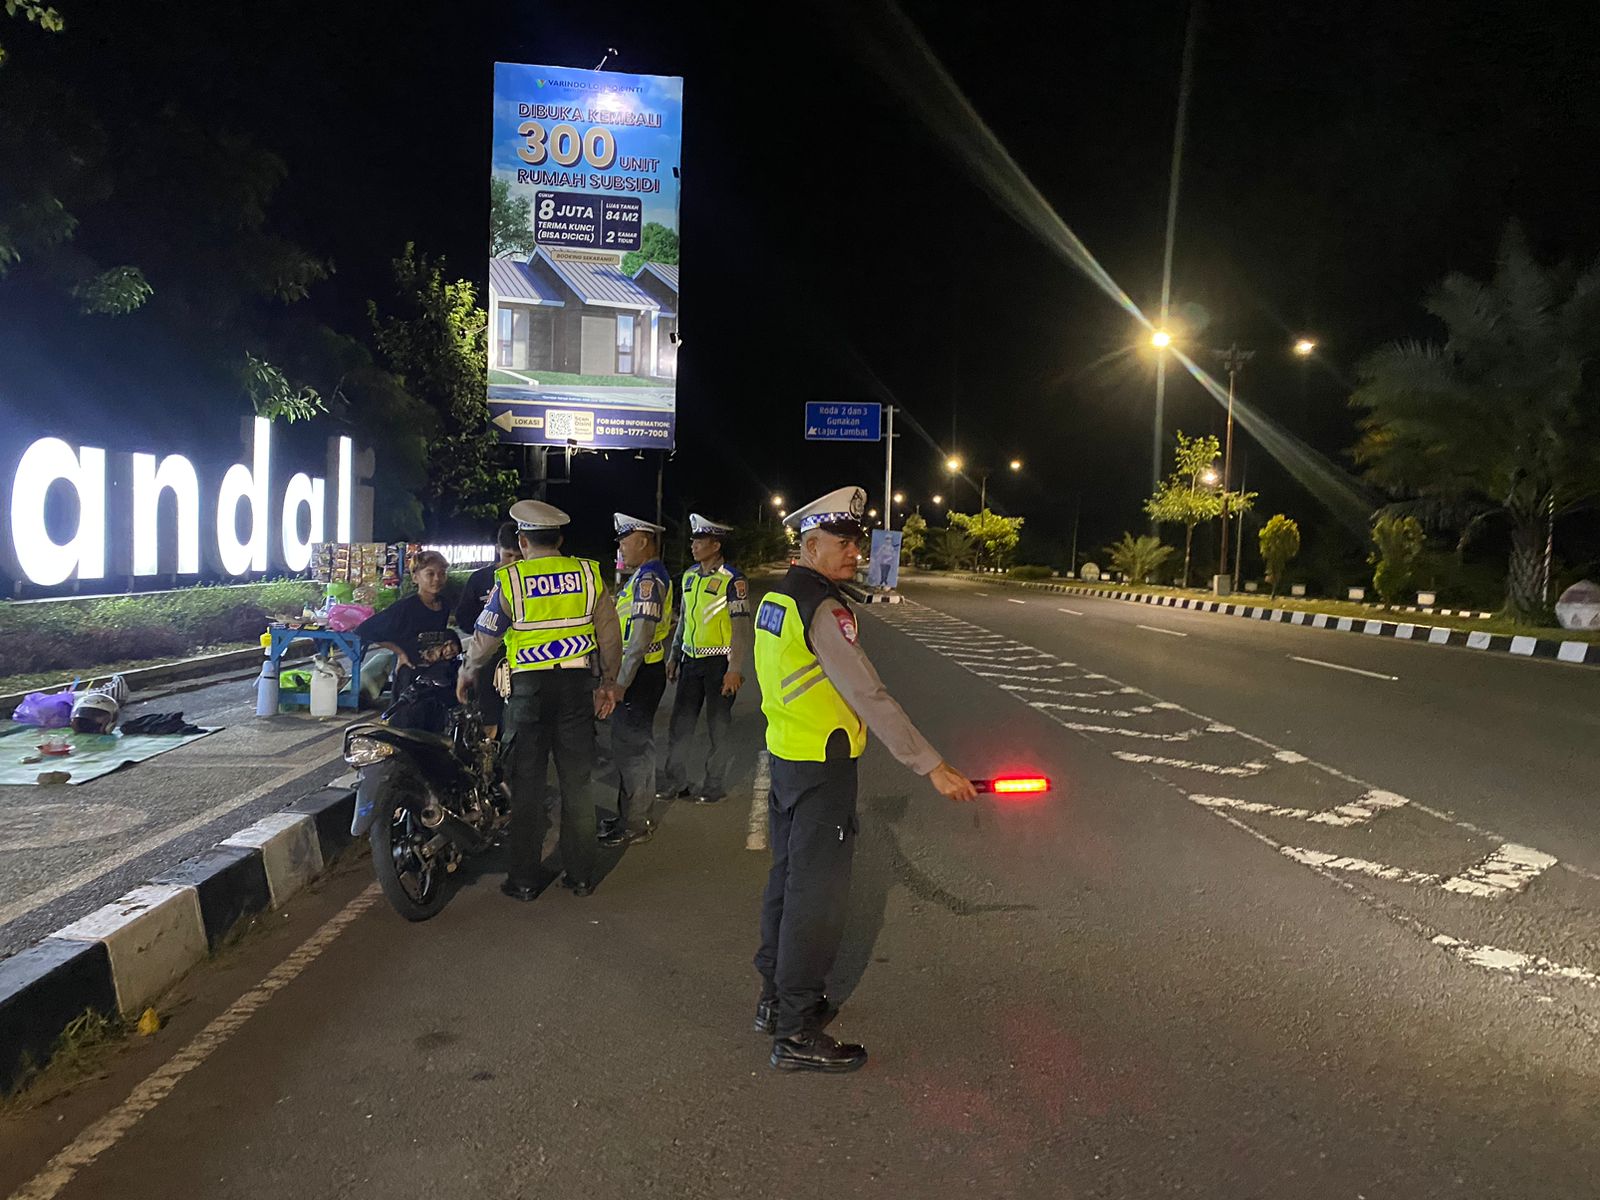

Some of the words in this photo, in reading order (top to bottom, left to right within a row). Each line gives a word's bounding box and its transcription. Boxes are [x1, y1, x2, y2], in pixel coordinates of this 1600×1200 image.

[548, 80, 586, 89] VARINDO
[519, 103, 585, 122] DIBUKA
[588, 108, 661, 128] KEMBALI
[517, 121, 617, 170] 300
[620, 156, 660, 172] UNIT
[517, 169, 586, 188] RUMAH
[589, 173, 660, 192] SUBSIDI
[538, 199, 555, 220] 8
[557, 205, 593, 219] JUTA
[605, 211, 619, 221] 84
[622, 212, 639, 222] M2
[538, 221, 567, 230] TERIMA
[568, 223, 595, 232] KUNCI
[537, 229, 560, 240] (BISA
[561, 231, 595, 243] DICICIL)
[605, 231, 615, 243] 2
[820, 406, 838, 415] Roda
[841, 407, 846, 415] 2
[847, 406, 861, 415] dan
[863, 407, 868, 416] 3
[514, 418, 540, 426] LOKASI
[826, 417, 860, 426] Gunakan
[605, 427, 669, 438] 0819-1777-7008
[818, 427, 837, 436] Lajur
[840, 427, 868, 437] Lambat
[526, 572, 581, 597] POLISI
